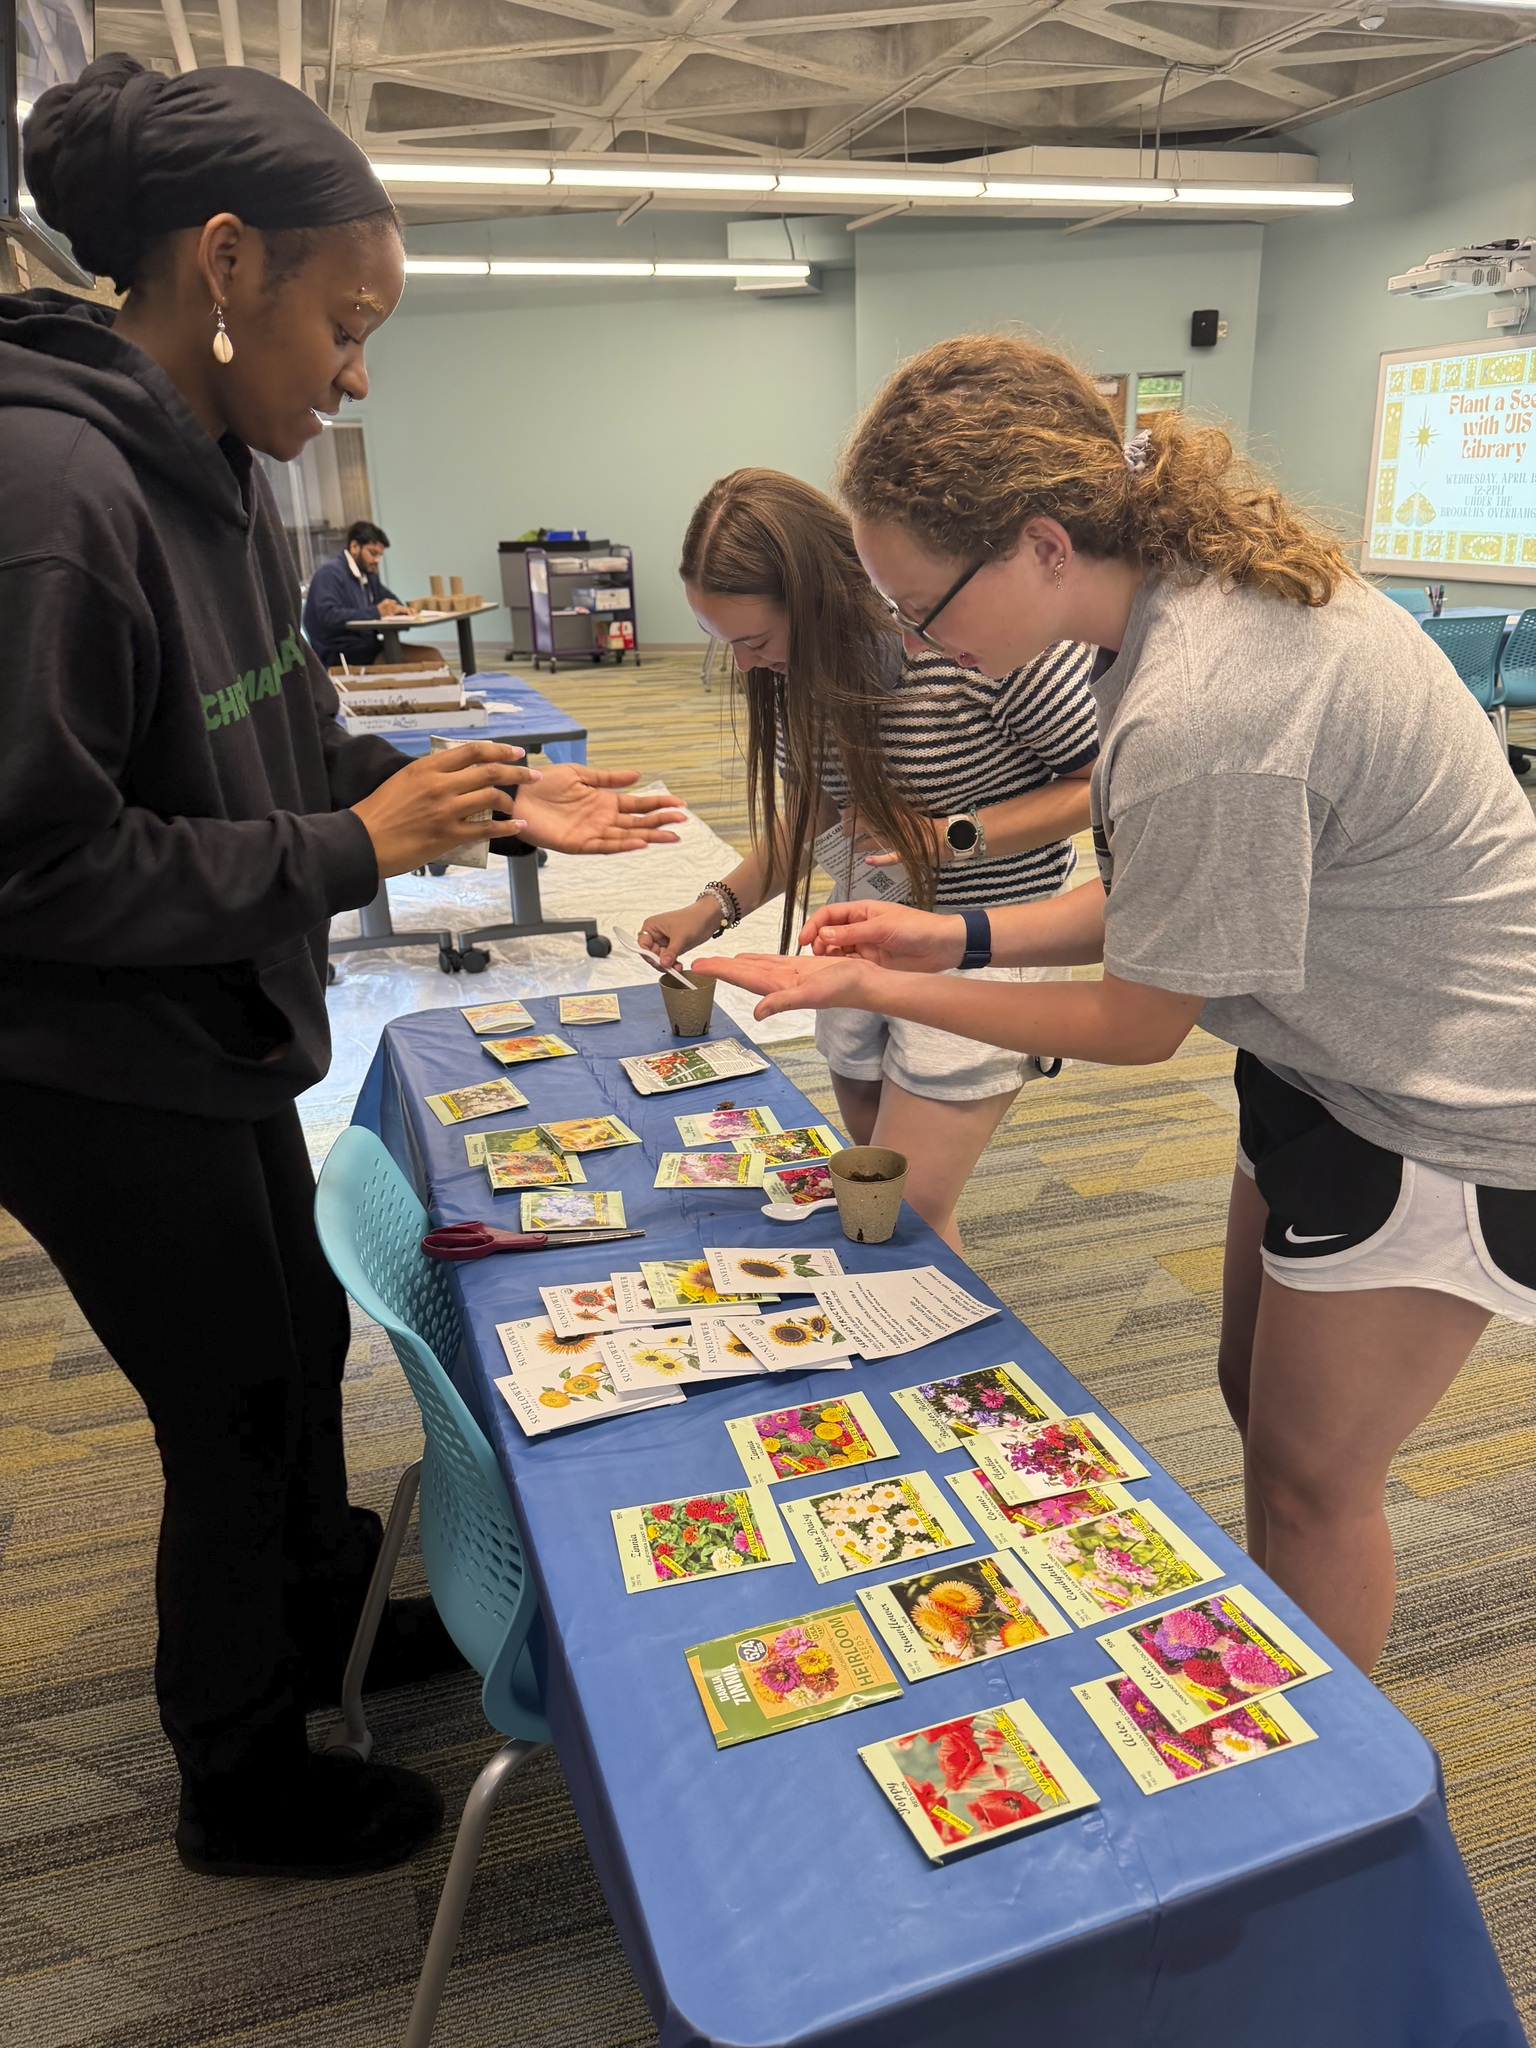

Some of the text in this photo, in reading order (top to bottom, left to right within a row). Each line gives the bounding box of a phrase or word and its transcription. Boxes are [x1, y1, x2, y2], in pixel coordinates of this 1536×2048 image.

[1449, 393, 1491, 415] Plant
[1495, 396, 1505, 412] a
[1463, 412, 1532, 437] with UIS
[1461, 439, 1527, 463] Library
[1473, 484, 1505, 496] 12-2PM
[1501, 472, 1528, 484] APRIL
[1440, 506, 1485, 518] BROOKENS
[1464, 495, 1513, 507] UNDER THE
[714, 1251, 731, 1285] SUNFLOWER
[620, 1276, 634, 1312] SUNFLOWER
[548, 1291, 570, 1328] SUNFLOWER
[821, 1291, 855, 1335] INSTRUCTIONS
[505, 1326, 527, 1366] SUNFLOWER
[700, 1322, 717, 1363] SUNFLOWER
[739, 1323, 779, 1361] SUNFLOWER
[853, 1336, 868, 1348] SEED
[606, 1340, 632, 1382] SUNFLOWER
[508, 1381, 540, 1424] SUNFLOWER
[1012, 1393, 1034, 1412] VALLEY
[747, 1440, 760, 1460] Zinnia
[848, 1429, 864, 1448] VALLEY
[984, 1456, 1005, 1480] Clarkia
[1091, 1450, 1111, 1469] VALLEY
[1086, 1487, 1102, 1502] VALL
[902, 1489, 937, 1535] VALLEY GREENE
[976, 1495, 997, 1521] Cosmos
[735, 1503, 758, 1550] VALLEY GREENE
[802, 1514, 832, 1562] Shasta Daisy
[629, 1534, 641, 1558] Zinnia
[644, 1543, 652, 1565] CALIFORNIA
[1133, 1521, 1186, 1571] VALLEY GREENE
[1047, 1553, 1063, 1571] COLORS
[983, 1572, 1008, 1598] GREENE
[1040, 1563, 1078, 1601] Candytuft
[1061, 1570, 1072, 1581] MIXED
[865, 1591, 874, 1601] 59¢
[1003, 1600, 1029, 1625] VALLEY
[807, 1625, 819, 1640] USA
[881, 1603, 916, 1653] Strawflower
[1228, 1610, 1284, 1664] VALLEY GREENE
[740, 1641, 760, 1661] 524
[828, 1616, 874, 1687] HEIRLOOM
[853, 1635, 872, 1660] SEEDS
[1104, 1638, 1115, 1648] 59¢
[720, 1663, 751, 1706] ZINNIA
[1131, 1643, 1189, 1705] POWDERPUFF MIXED COLORS
[1141, 1666, 1164, 1689] Aster
[712, 1675, 730, 1702] DAHLIA
[1080, 1689, 1091, 1700] 59¢
[1244, 1702, 1269, 1728] VALLE
[1110, 1696, 1163, 1765] CREGO GIANT MIXED COLORS
[1116, 1721, 1137, 1747] Aster
[1001, 1725, 1052, 1789] VALLEY GREENE
[901, 1781, 919, 1808] RED CORN
